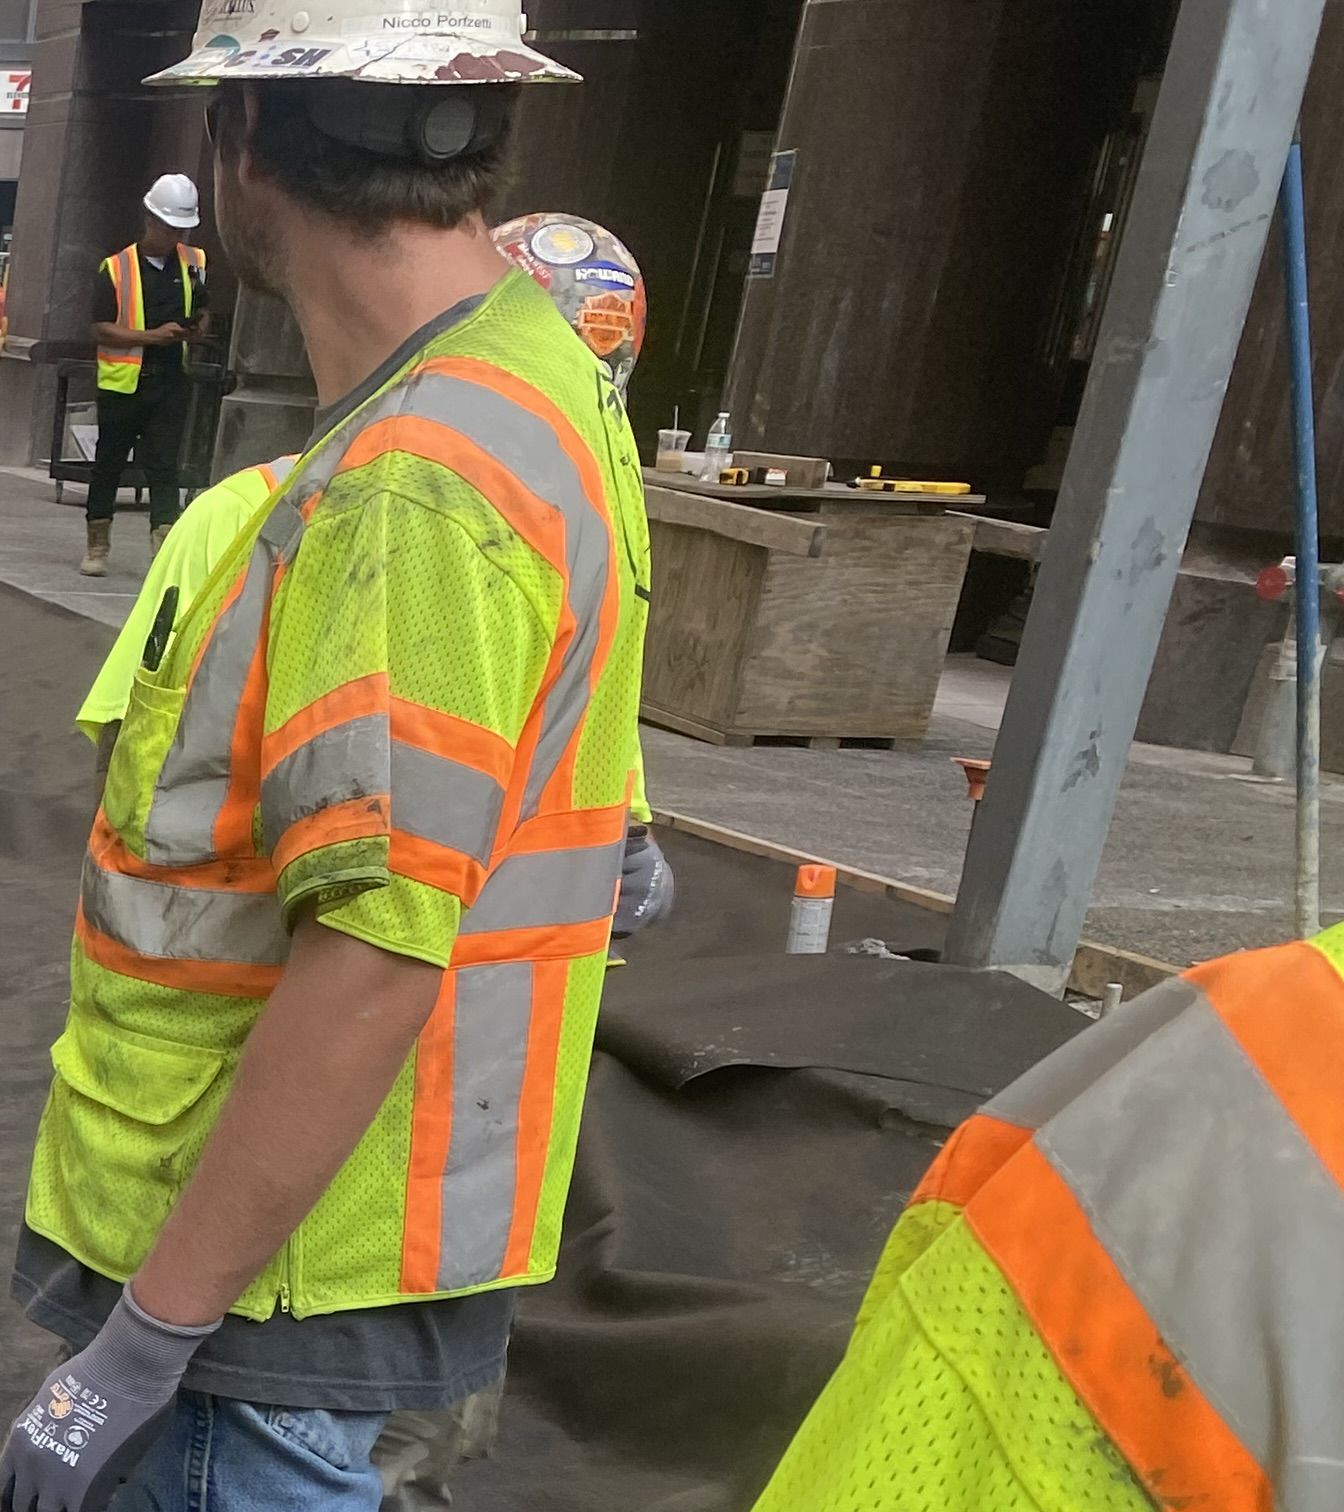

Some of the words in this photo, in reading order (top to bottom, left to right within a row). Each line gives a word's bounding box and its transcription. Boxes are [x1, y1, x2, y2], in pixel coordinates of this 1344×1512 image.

[382, 16, 431, 29] Nicco
[9, 75, 32, 109] 7
[21, 1418, 80, 1467] MaxiFlex
